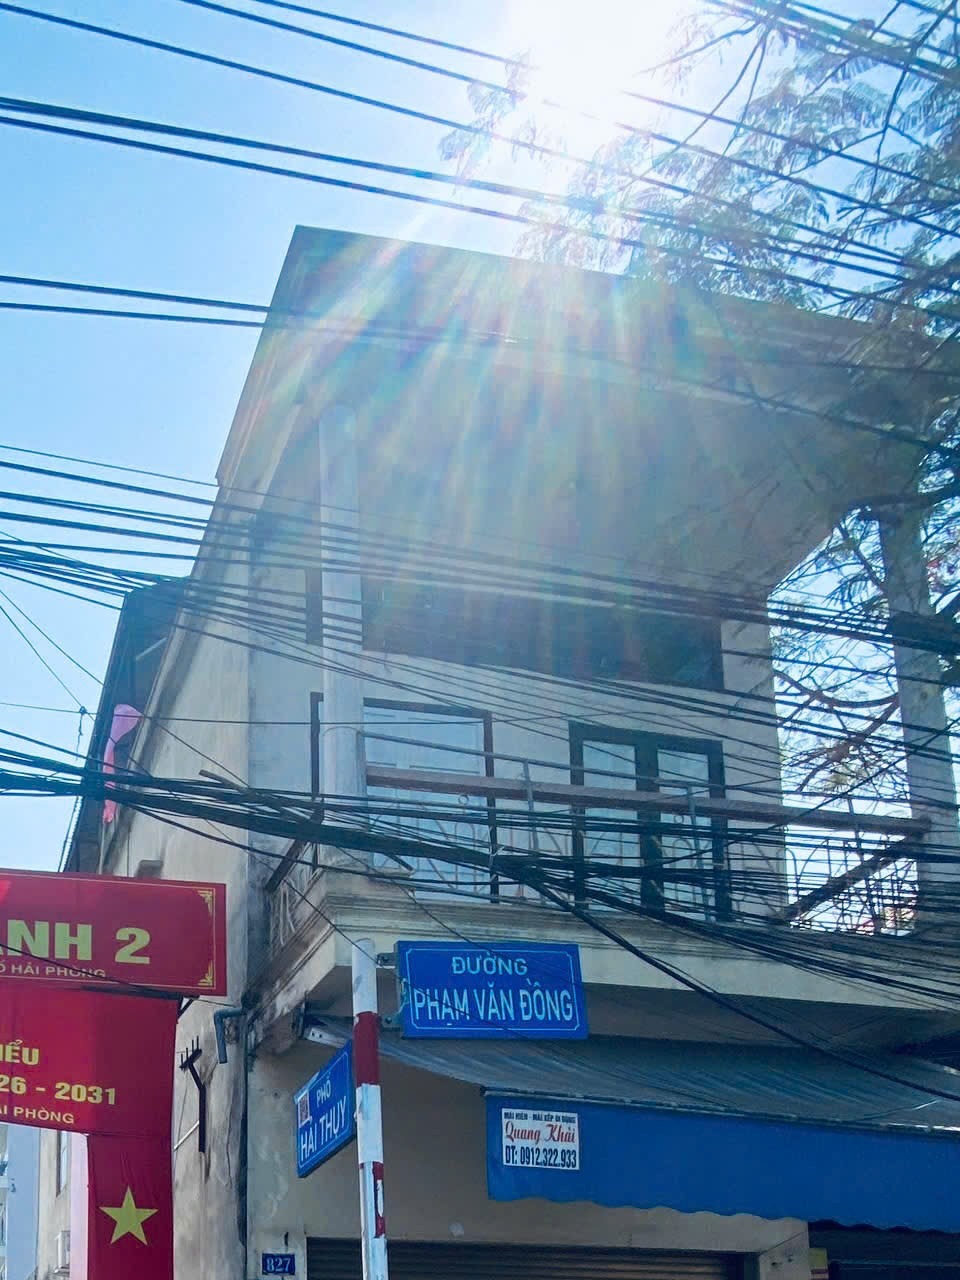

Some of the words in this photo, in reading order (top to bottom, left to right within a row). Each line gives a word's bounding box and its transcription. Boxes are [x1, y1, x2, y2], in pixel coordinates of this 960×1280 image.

[114, 926, 151, 965] 2
[11, 962, 39, 975] HẢI
[45, 965, 106, 979] PHÒNG
[451, 952, 528, 976] ĐƯỜNG
[413, 988, 470, 1026] PHẠM
[473, 982, 515, 1021] VĂN
[519, 978, 573, 1021] ĐỒNG
[54, 1081, 117, 1105] 2031
[316, 1073, 332, 1108] PHỐ
[13, 1105, 75, 1124] PHÒNG
[320, 1095, 347, 1146] THỤY
[505, 1120, 541, 1145] Quang
[520, 1146, 577, 1169] 0912.322.933
[266, 1257, 291, 1272] 827
